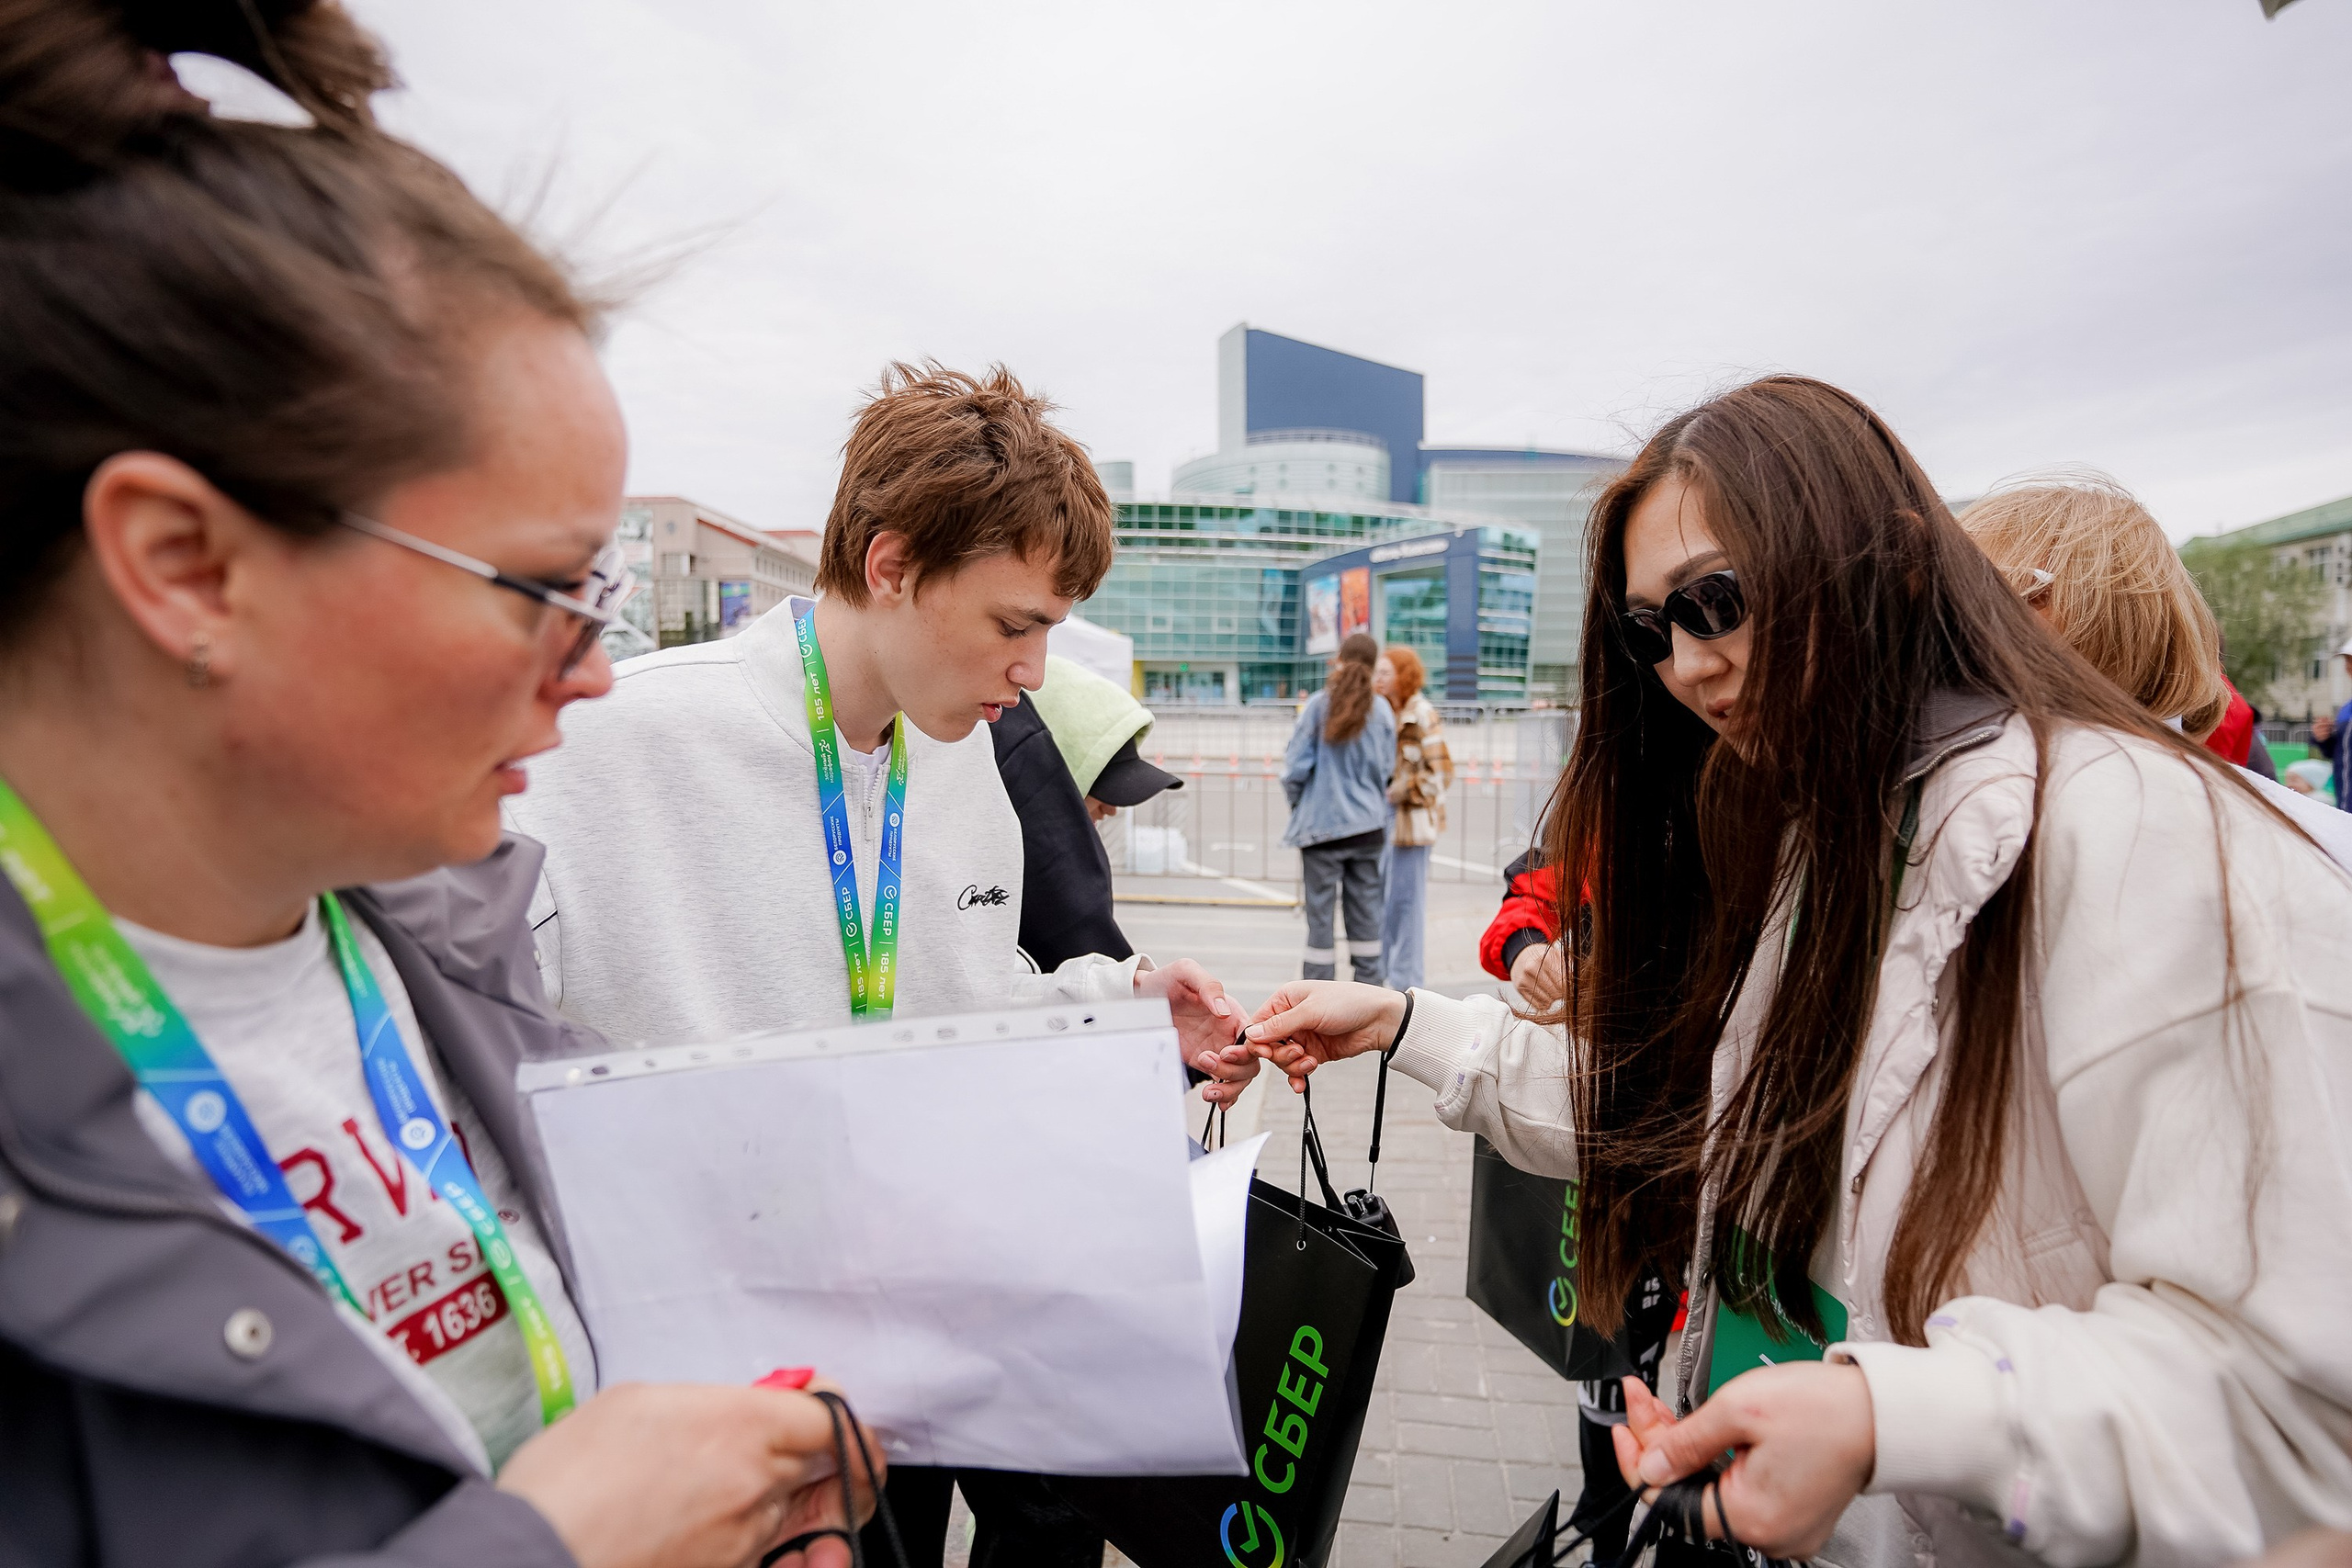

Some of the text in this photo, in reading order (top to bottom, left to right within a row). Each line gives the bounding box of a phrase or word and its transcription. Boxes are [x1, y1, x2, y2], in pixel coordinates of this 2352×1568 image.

[797, 618, 808, 643] СБЕР
[809, 672, 825, 721] 185 лет
[842, 886, 854, 920] СБЕР
[883, 902, 894, 937] СБЕР
[857, 976, 865, 998] 185
[878, 952, 889, 999] 185 лет
[422, 1280, 497, 1350] 1636
[1254, 1325, 1329, 1494] СБЕР
